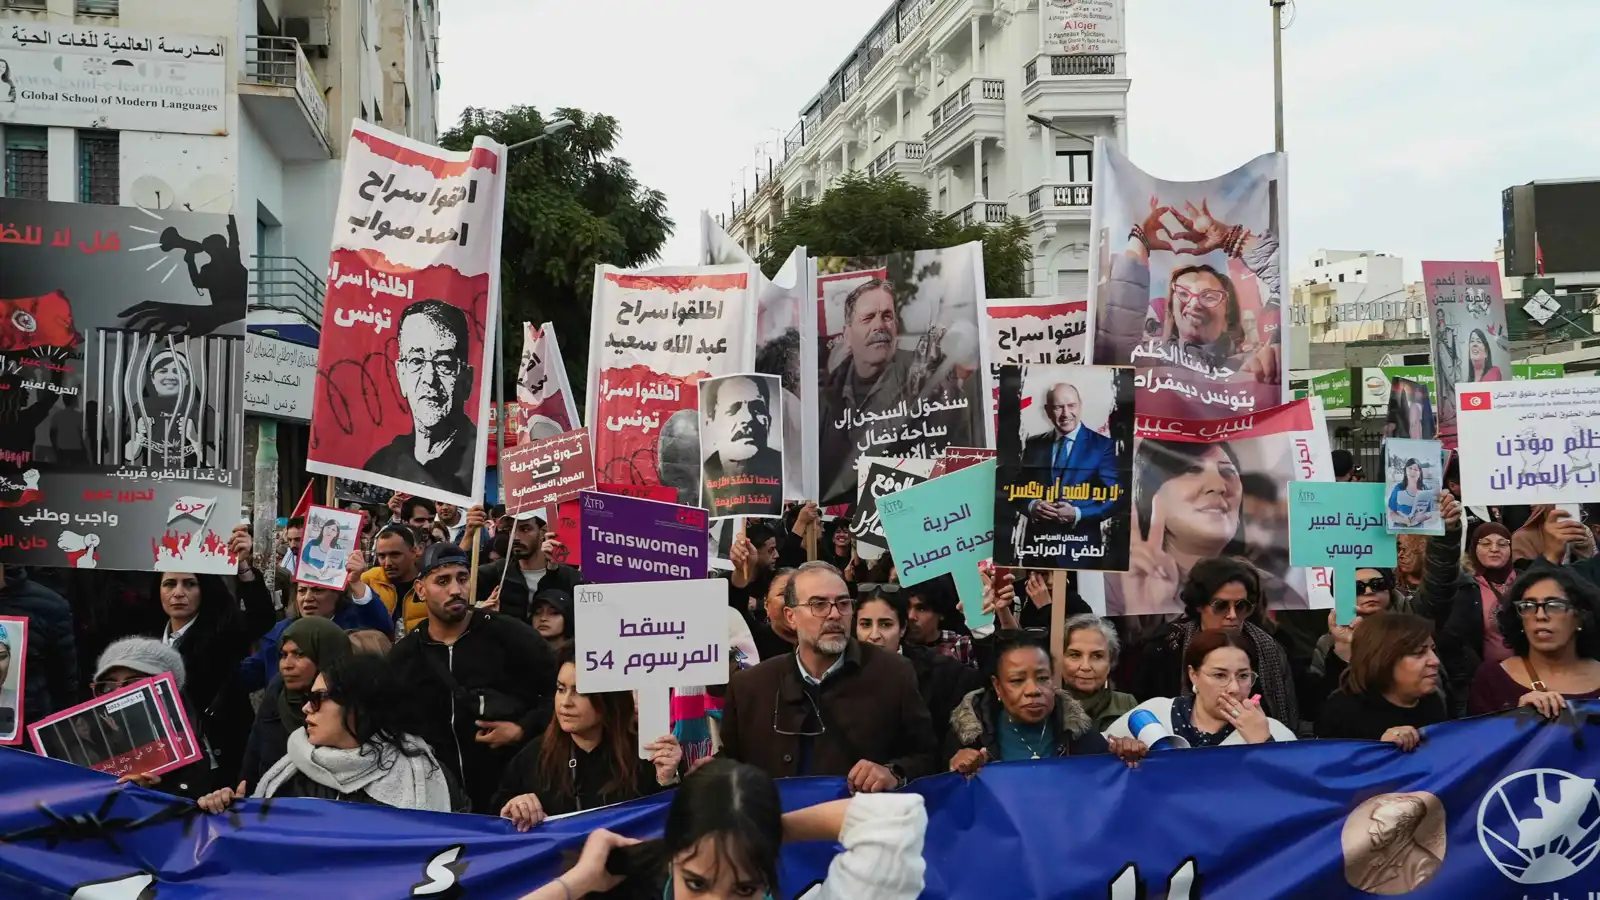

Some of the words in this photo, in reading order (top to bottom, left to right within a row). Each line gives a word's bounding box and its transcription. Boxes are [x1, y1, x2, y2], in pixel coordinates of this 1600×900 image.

[158, 36, 224, 58] المدرسة
[21, 90, 58, 102] Global
[62, 92, 98, 104] School
[101, 95, 112, 104] of
[115, 96, 158, 108] Modern
[161, 99, 218, 112] Languages
[358, 170, 428, 204] سراح
[51, 226, 72, 248] لا
[348, 210, 415, 242] صواب
[76, 230, 121, 255] قل
[328, 262, 363, 290] سرا
[366, 268, 414, 300] اطلقوا
[334, 304, 392, 335] تونس
[616, 300, 668, 326] سراح
[672, 300, 724, 327] اطلقوا
[604, 332, 658, 355] سعيد
[662, 334, 694, 354] الله
[695, 336, 728, 360] عبد
[998, 326, 1044, 350] سراح
[1180, 347, 1236, 382] جريمتنا
[20, 379, 46, 390] لعبير
[48, 382, 78, 396] الحرية
[274, 375, 300, 387] المكتب
[600, 380, 634, 402] سرا
[244, 390, 270, 407] المدينة
[636, 382, 680, 404] اطلقوا
[1200, 388, 1256, 412] بتونس
[274, 400, 296, 412] تونس
[854, 400, 908, 426] السجن
[606, 408, 660, 434] تونس
[834, 408, 852, 430] إلى
[856, 428, 899, 450] نضال
[900, 424, 948, 442] ساحة
[1496, 432, 1554, 456] مؤذن
[553, 442, 583, 462] ثورة
[1296, 438, 1315, 480] الحزب
[510, 454, 552, 473] كويرية
[532, 462, 561, 480] ضد
[512, 478, 557, 497] الاستعمارية
[756, 475, 780, 486] عندما
[1490, 464, 1566, 490] العمران
[1046, 476, 1060, 502] أن
[1062, 482, 1090, 502] للقيد
[1093, 486, 1107, 504] بد
[176, 500, 206, 514] حرية
[714, 496, 746, 508] العزيمة
[19, 508, 70, 526] وطني
[74, 510, 118, 526] واجب
[923, 503, 972, 532] الحرية
[1308, 512, 1340, 530] لعبير
[18, 536, 48, 550] حان
[588, 525, 699, 558] Transwomen
[1034, 534, 1060, 543] السياسي
[1061, 534, 1088, 542] المعتقل
[902, 545, 952, 576] مصباح
[1016, 543, 1066, 559] المرايحي
[1071, 545, 1105, 562] لطفي
[596, 551, 624, 567] are
[627, 556, 691, 579] women
[619, 618, 686, 640] يسقط
[586, 650, 614, 672] 54
[624, 644, 719, 675] المرسوم
